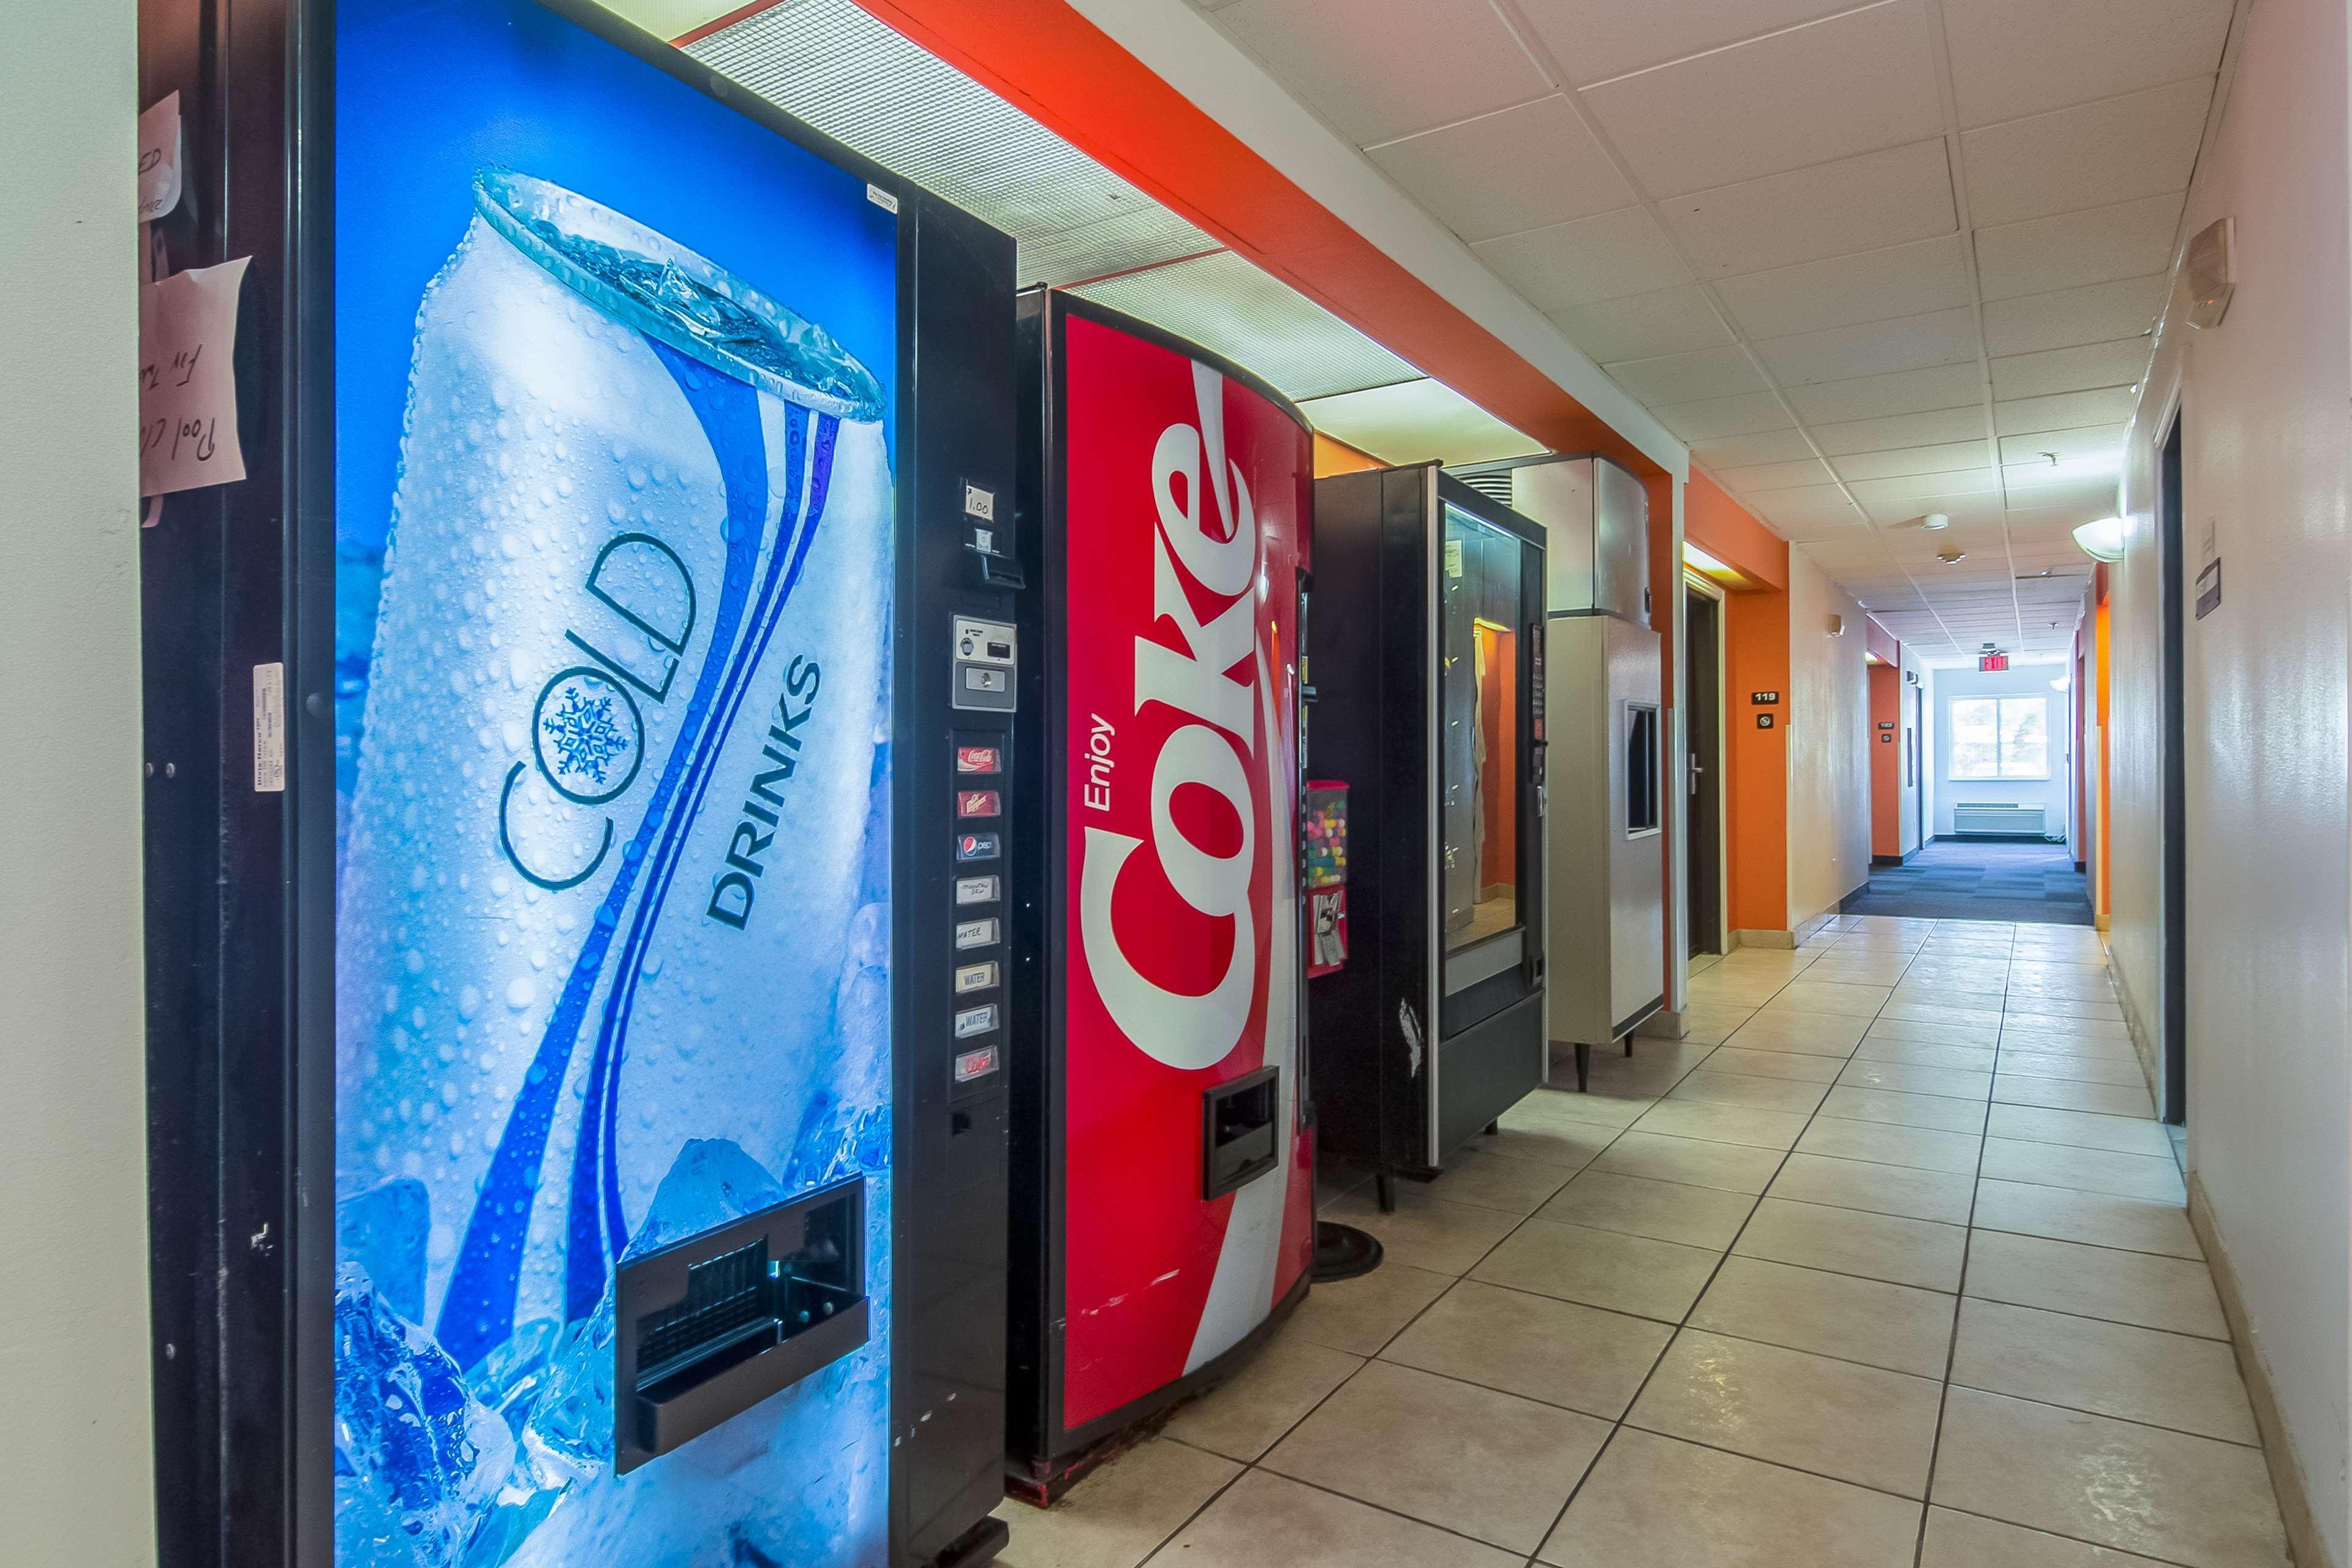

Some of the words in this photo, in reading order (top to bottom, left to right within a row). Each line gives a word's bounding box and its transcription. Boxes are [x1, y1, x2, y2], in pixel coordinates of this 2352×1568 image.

[172, 417, 215, 462] Pool
[969, 497, 989, 514] 1.00
[1984, 657, 2004, 671] EXIT
[499, 532, 696, 892] COLD
[1080, 423, 1257, 1071] Coke
[706, 654, 822, 930] DRINKS
[1084, 712, 1115, 812] Enjoy
[964, 971, 985, 986] WATER
